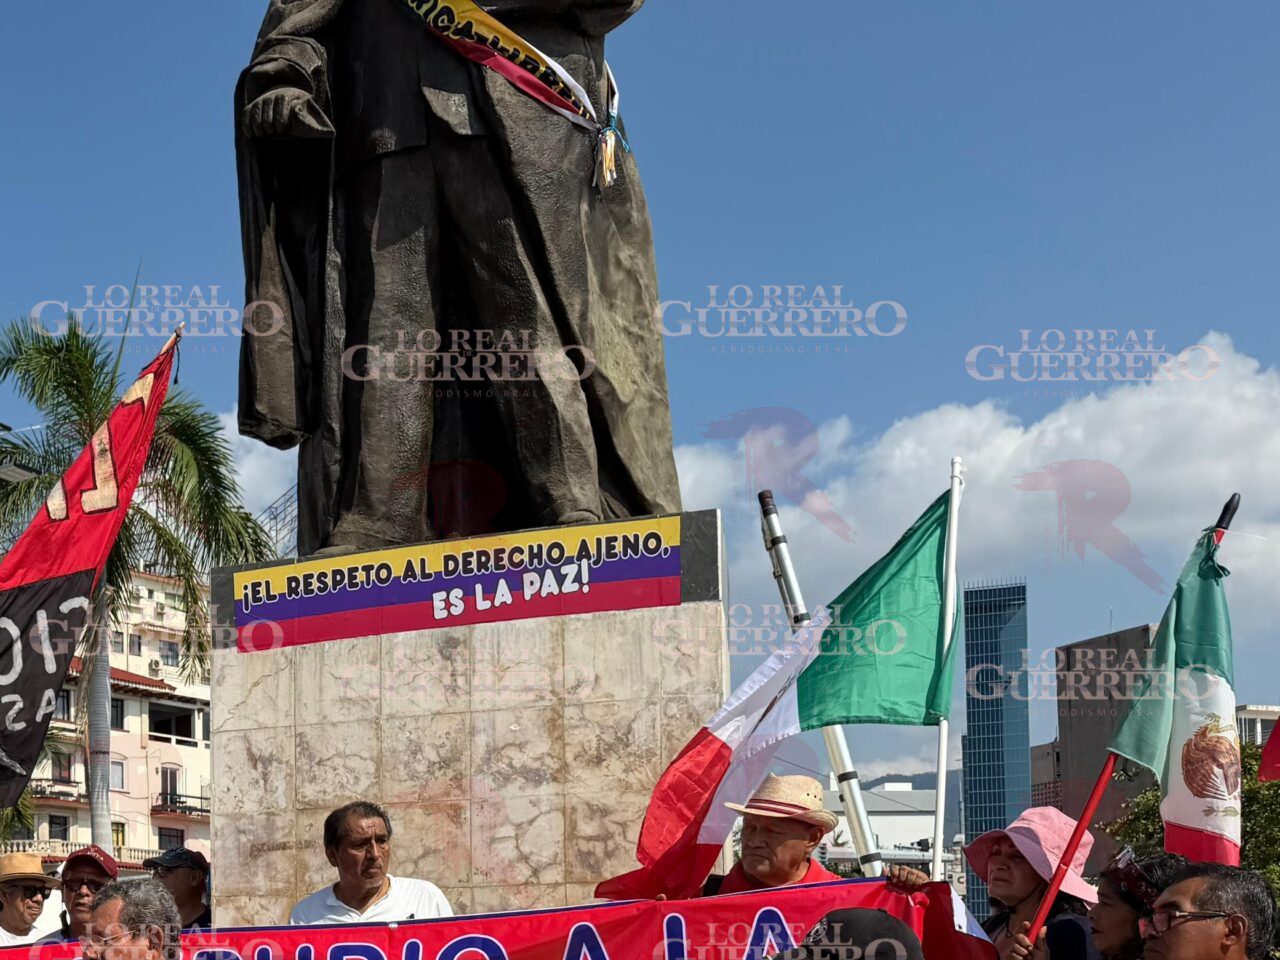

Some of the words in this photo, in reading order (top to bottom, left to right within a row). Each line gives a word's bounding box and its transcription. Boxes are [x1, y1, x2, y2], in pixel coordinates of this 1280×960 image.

[242, 578, 278, 613] ¡EL
[286, 562, 394, 600] RESPETO
[400, 557, 434, 584] AL
[441, 539, 567, 580] DERECHO
[574, 531, 671, 568] AJENO,
[432, 590, 465, 620] ES
[475, 577, 513, 613] LA
[522, 558, 590, 601] PAZ!
